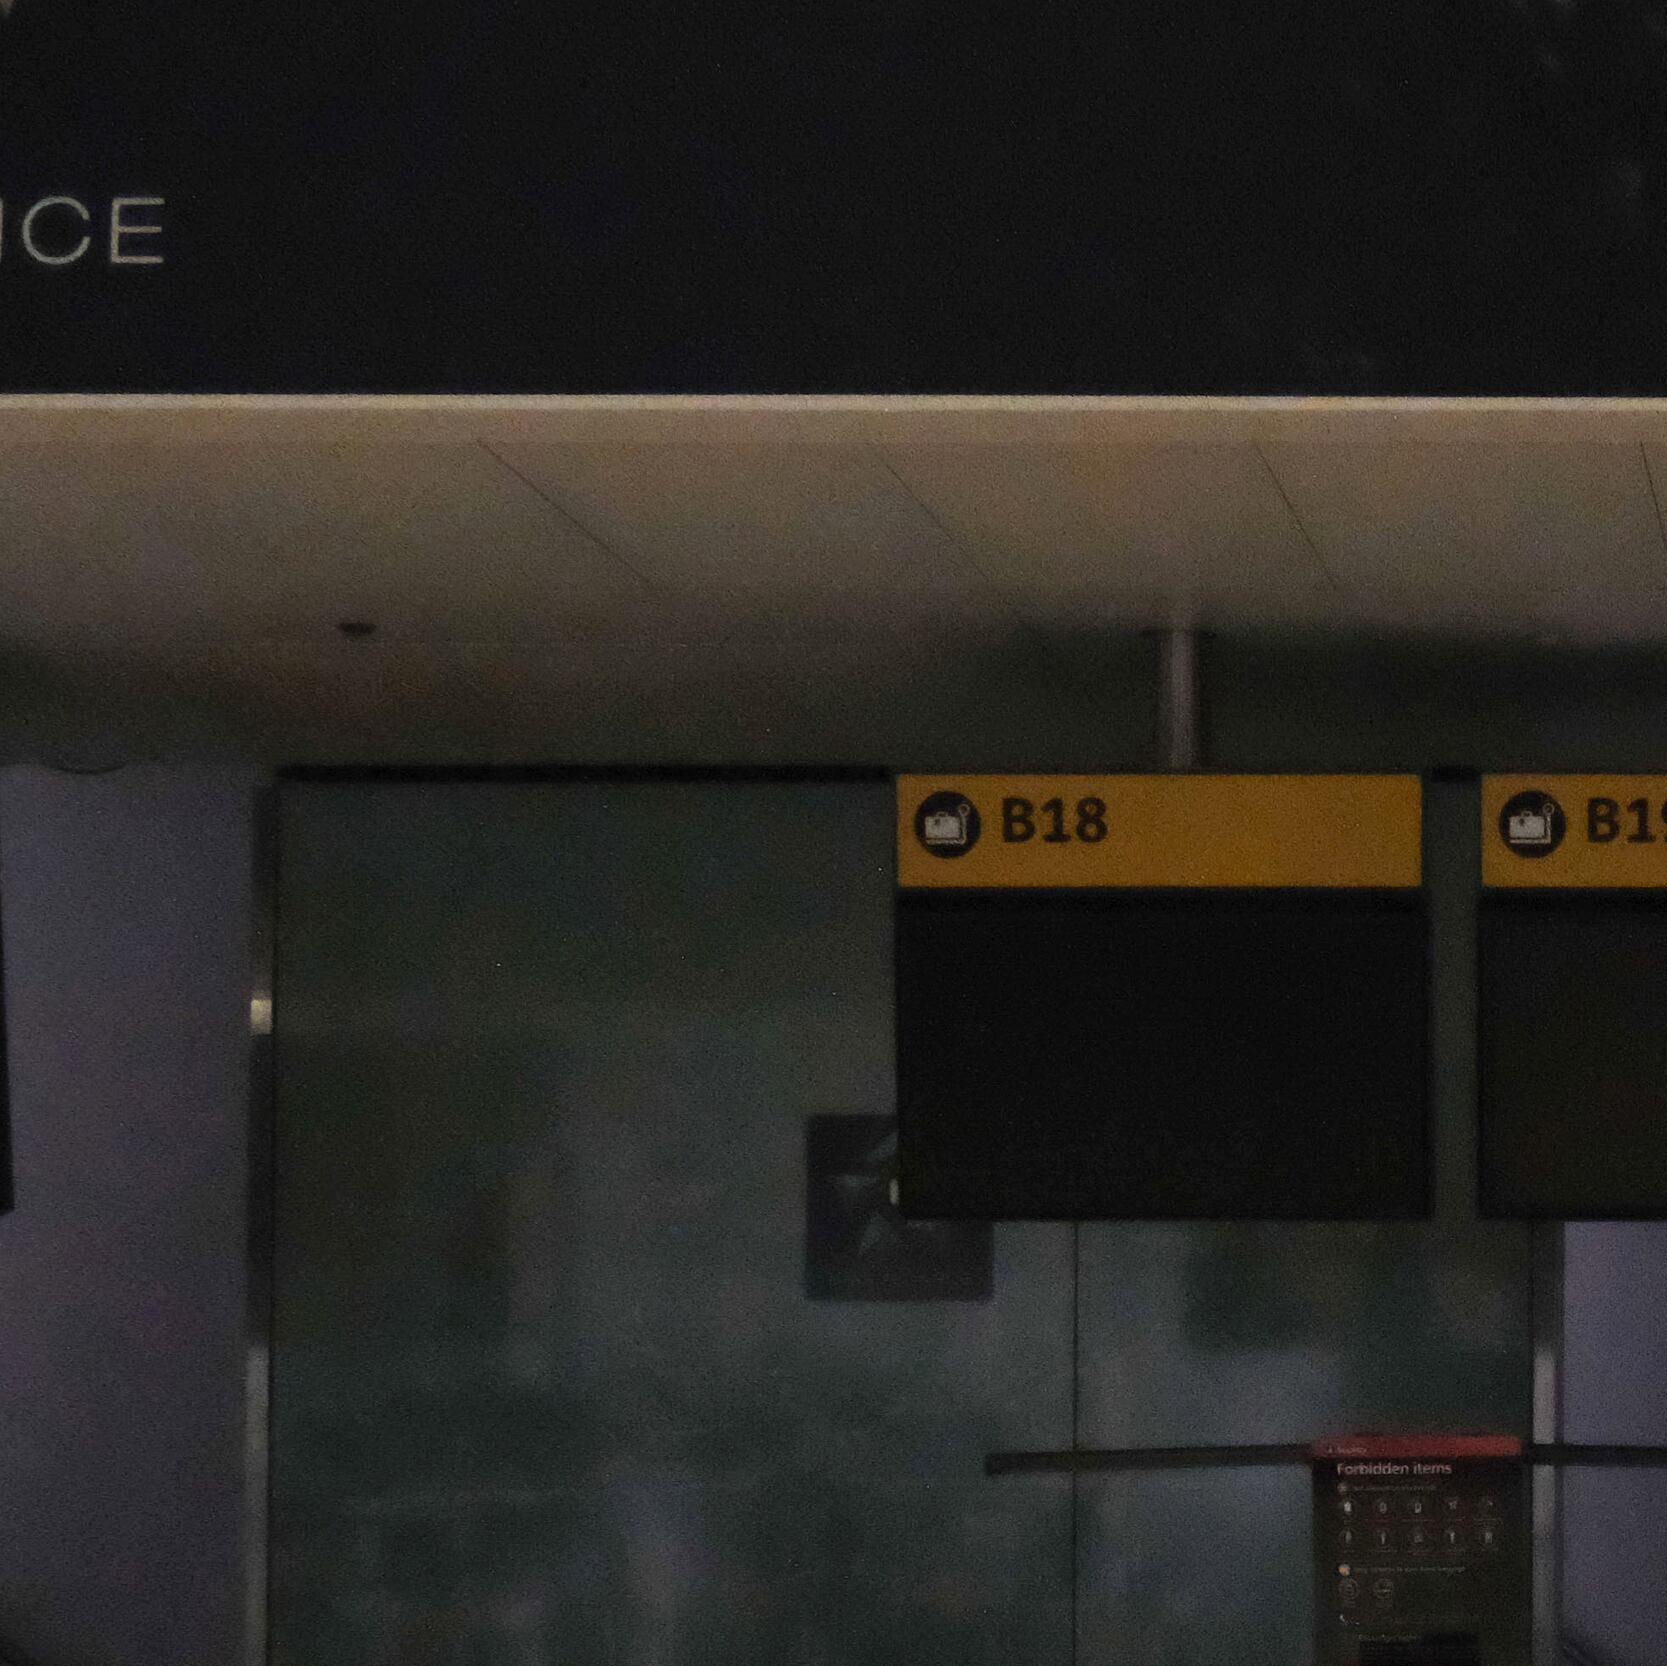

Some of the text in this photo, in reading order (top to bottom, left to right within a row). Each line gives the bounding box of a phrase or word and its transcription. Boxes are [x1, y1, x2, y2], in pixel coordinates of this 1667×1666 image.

[1002, 796, 1108, 842] B18
[1336, 1461, 1453, 1476] Forbidden items
